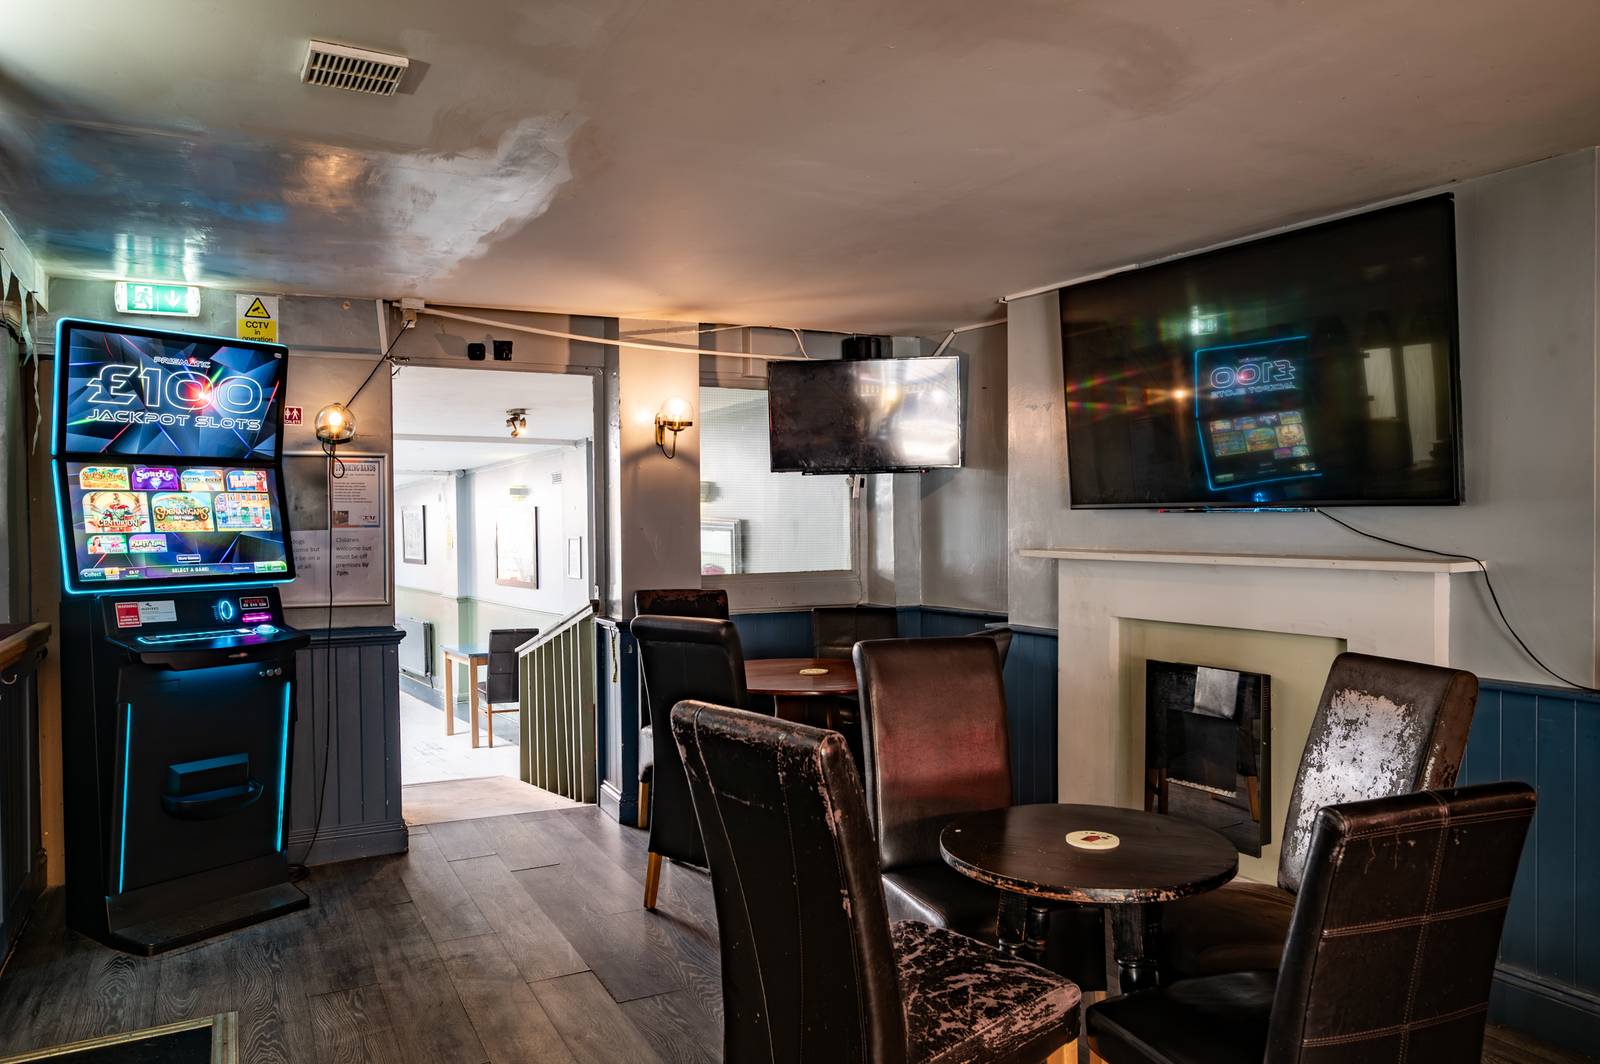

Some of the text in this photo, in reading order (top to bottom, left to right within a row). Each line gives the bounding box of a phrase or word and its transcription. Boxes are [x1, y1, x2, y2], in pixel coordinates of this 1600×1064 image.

[245, 321, 270, 329] CCTV
[241, 335, 274, 343] operation
[153, 355, 211, 369] PRISMATIC
[87, 364, 263, 414] £100
[86, 408, 261, 431] JACKPOT SLOTS
[136, 469, 174, 482] Sparkle
[97, 519, 139, 528] CENTURION
[83, 570, 102, 578] Collect
